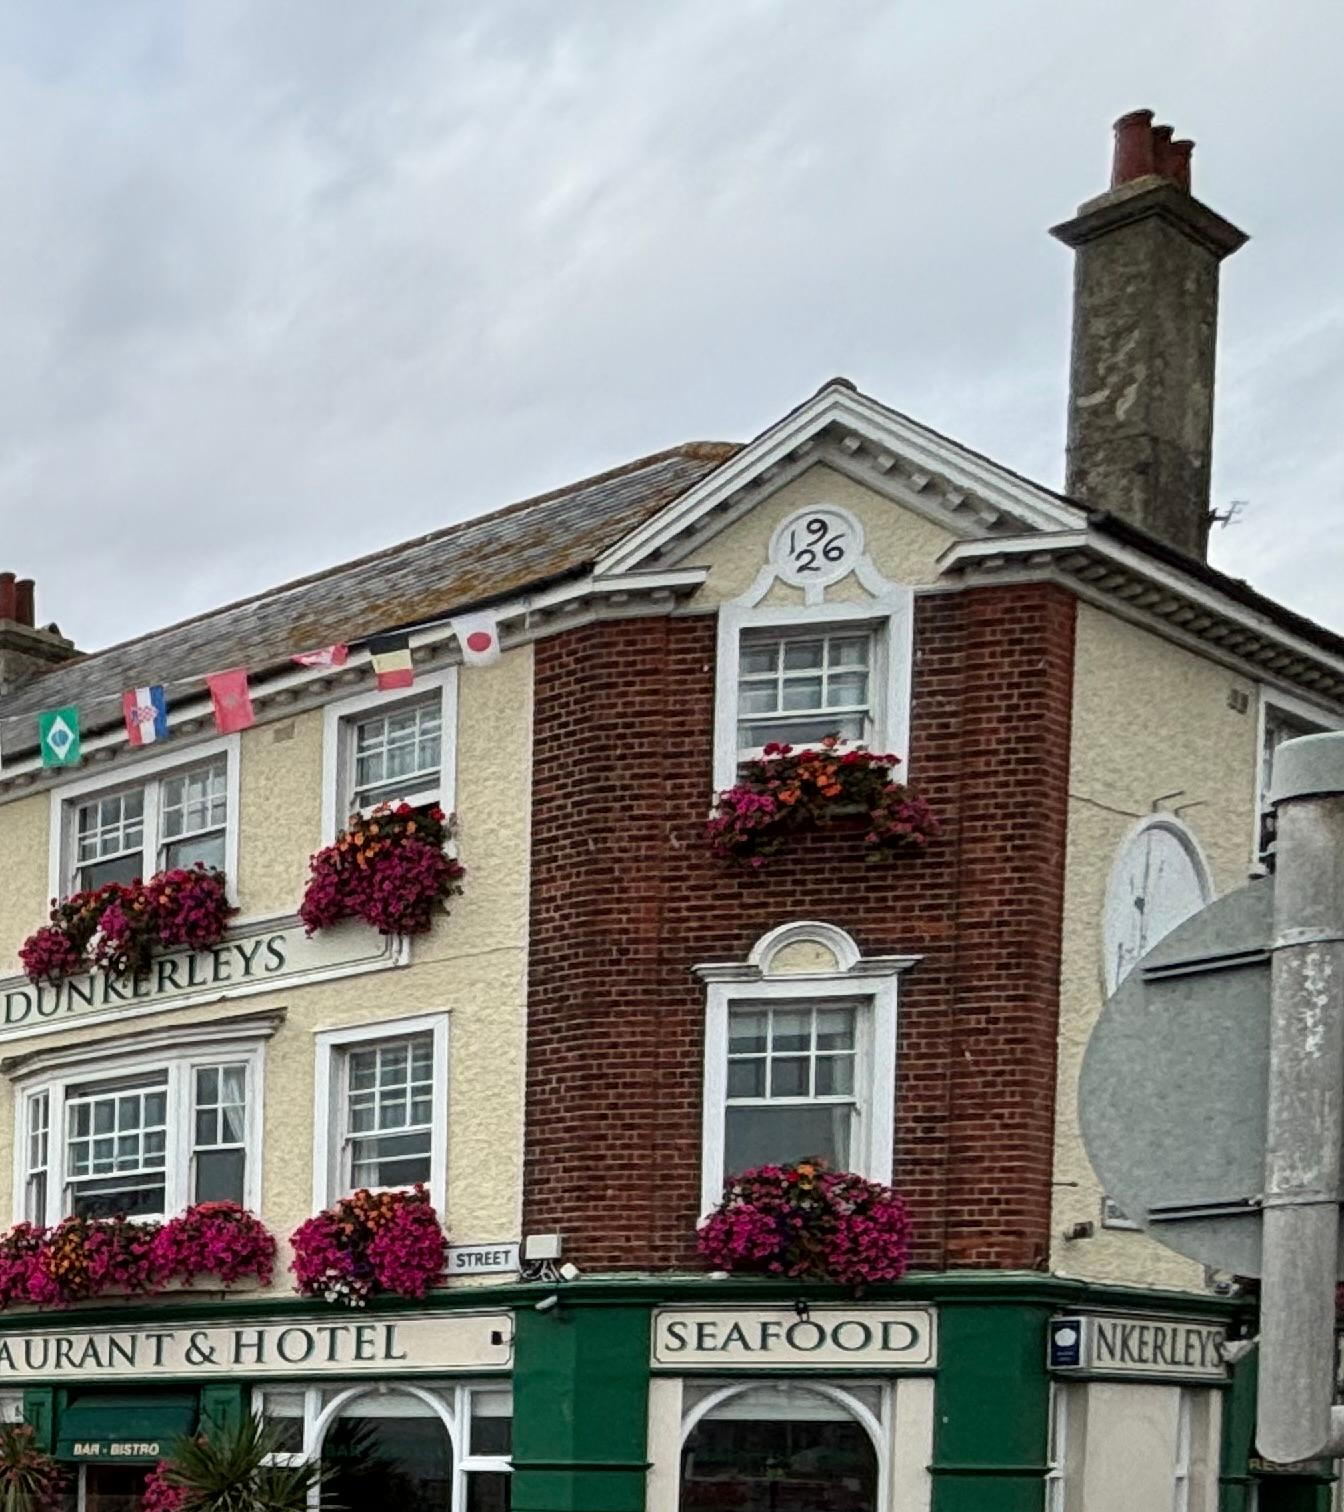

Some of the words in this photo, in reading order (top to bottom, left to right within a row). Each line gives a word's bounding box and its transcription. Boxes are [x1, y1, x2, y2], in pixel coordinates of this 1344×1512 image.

[4, 935, 287, 1024] DUNKERLEYS
[456, 1251, 511, 1268] STREET
[184, 1331, 217, 1366] &
[232, 1324, 408, 1364] HOTEL
[664, 1320, 920, 1352] SEAFOOD
[73, 1443, 100, 1455] BAR
[110, 1443, 160, 1456] BISTRO
